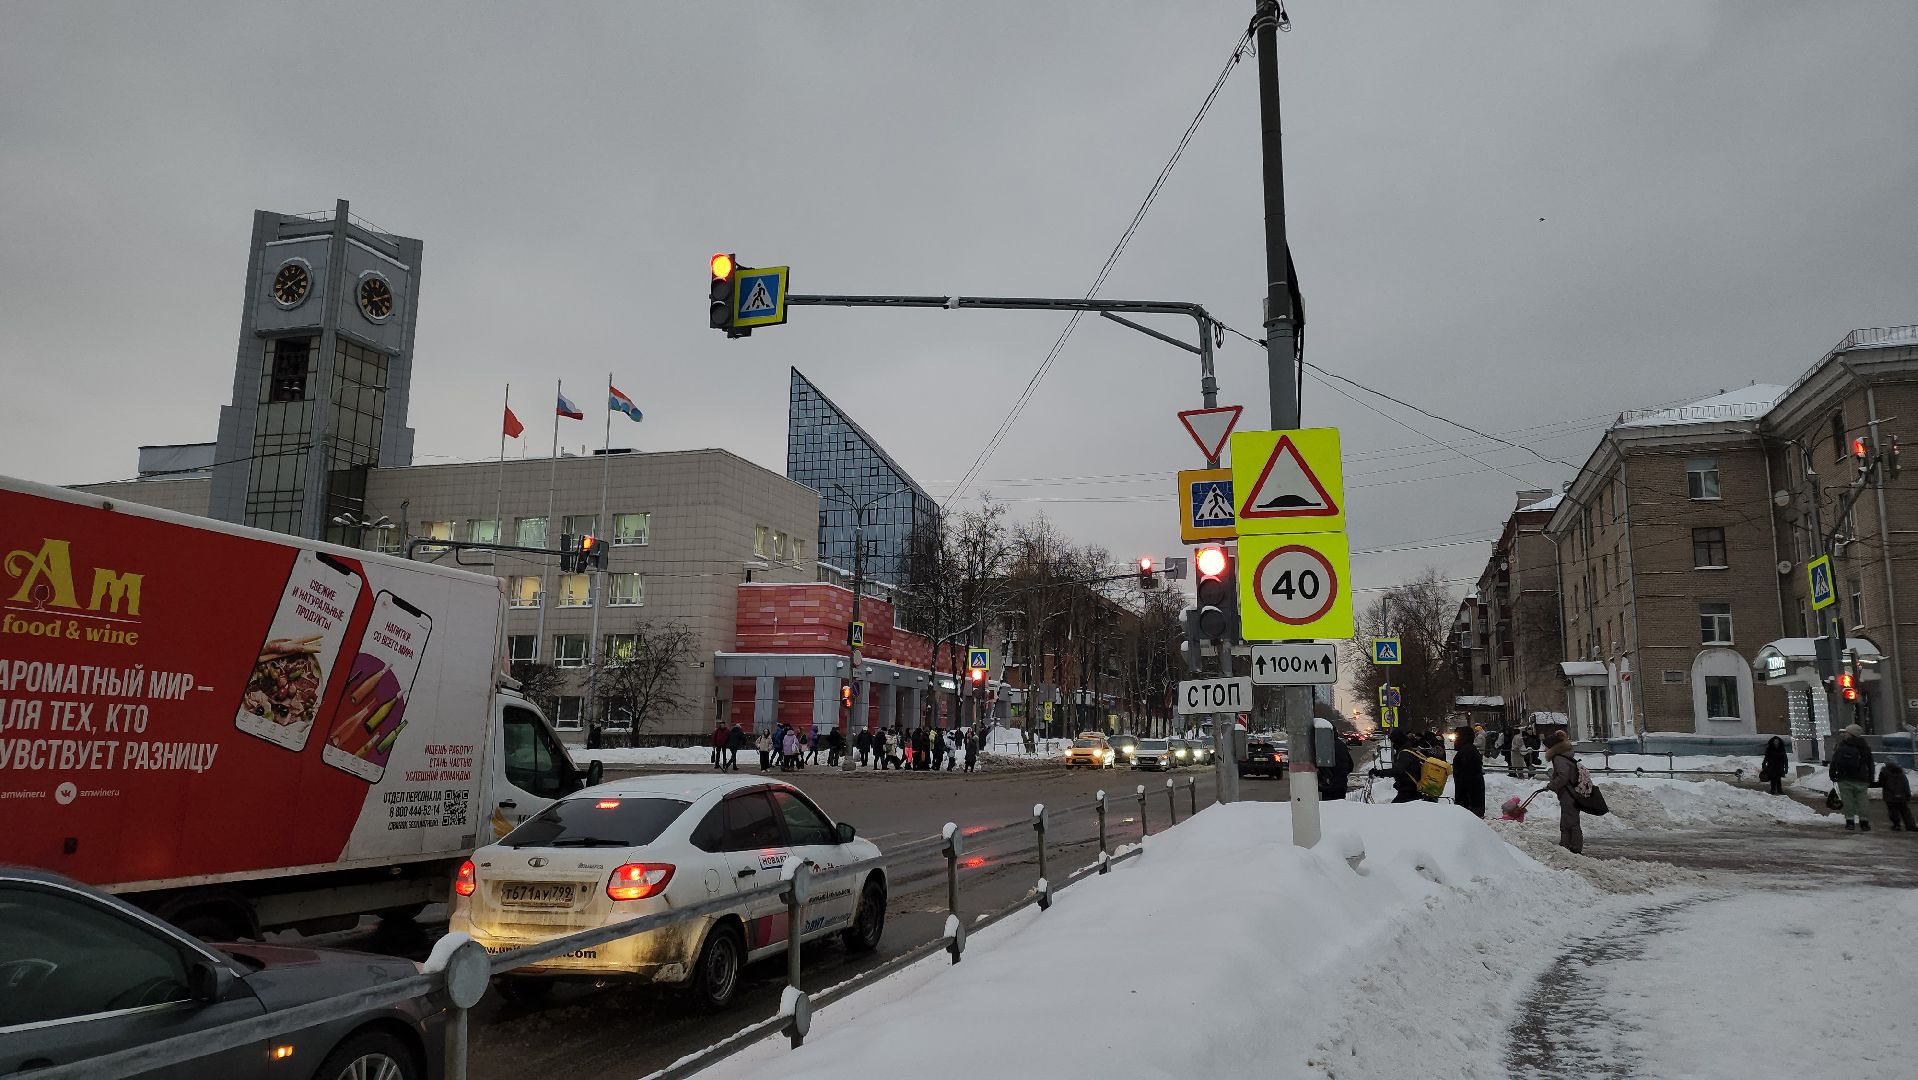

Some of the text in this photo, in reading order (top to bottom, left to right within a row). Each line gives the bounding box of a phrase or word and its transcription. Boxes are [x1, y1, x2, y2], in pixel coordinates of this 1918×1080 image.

[309, 579, 337, 601] СВЕЖИЕ
[1271, 569, 1320, 601] 40
[291, 585, 345, 622] И НАТУРАЛЬНЫЕ
[295, 604, 332, 631] ПРОДУКТЫ
[2, 613, 139, 646] food & wine
[384, 621, 412, 643] НАПИТКИ
[373, 630, 382, 641] СО
[382, 634, 399, 652] ВСЕГО
[0, 659, 145, 698] АРОМАТНЫЙ
[148, 670, 194, 700] МИР
[1187, 683, 1241, 708] СТОП
[0, 698, 149, 735] ЛЯ ТЕХ, КТО
[0, 738, 219, 774] УВСТВУЕТ РАЗНИЦУ
[429, 757, 473, 768] СТАНЬ ЧАСТЬЮ
[1, 789, 46, 799] amwineru
[80, 786, 121, 798] amwineru
[383, 789, 442, 804] ОТДЕЛ ПЕРСОНАЛА
[389, 806, 395, 818] 8
[395, 805, 409, 817] 800
[552, 886, 572, 900] 799
